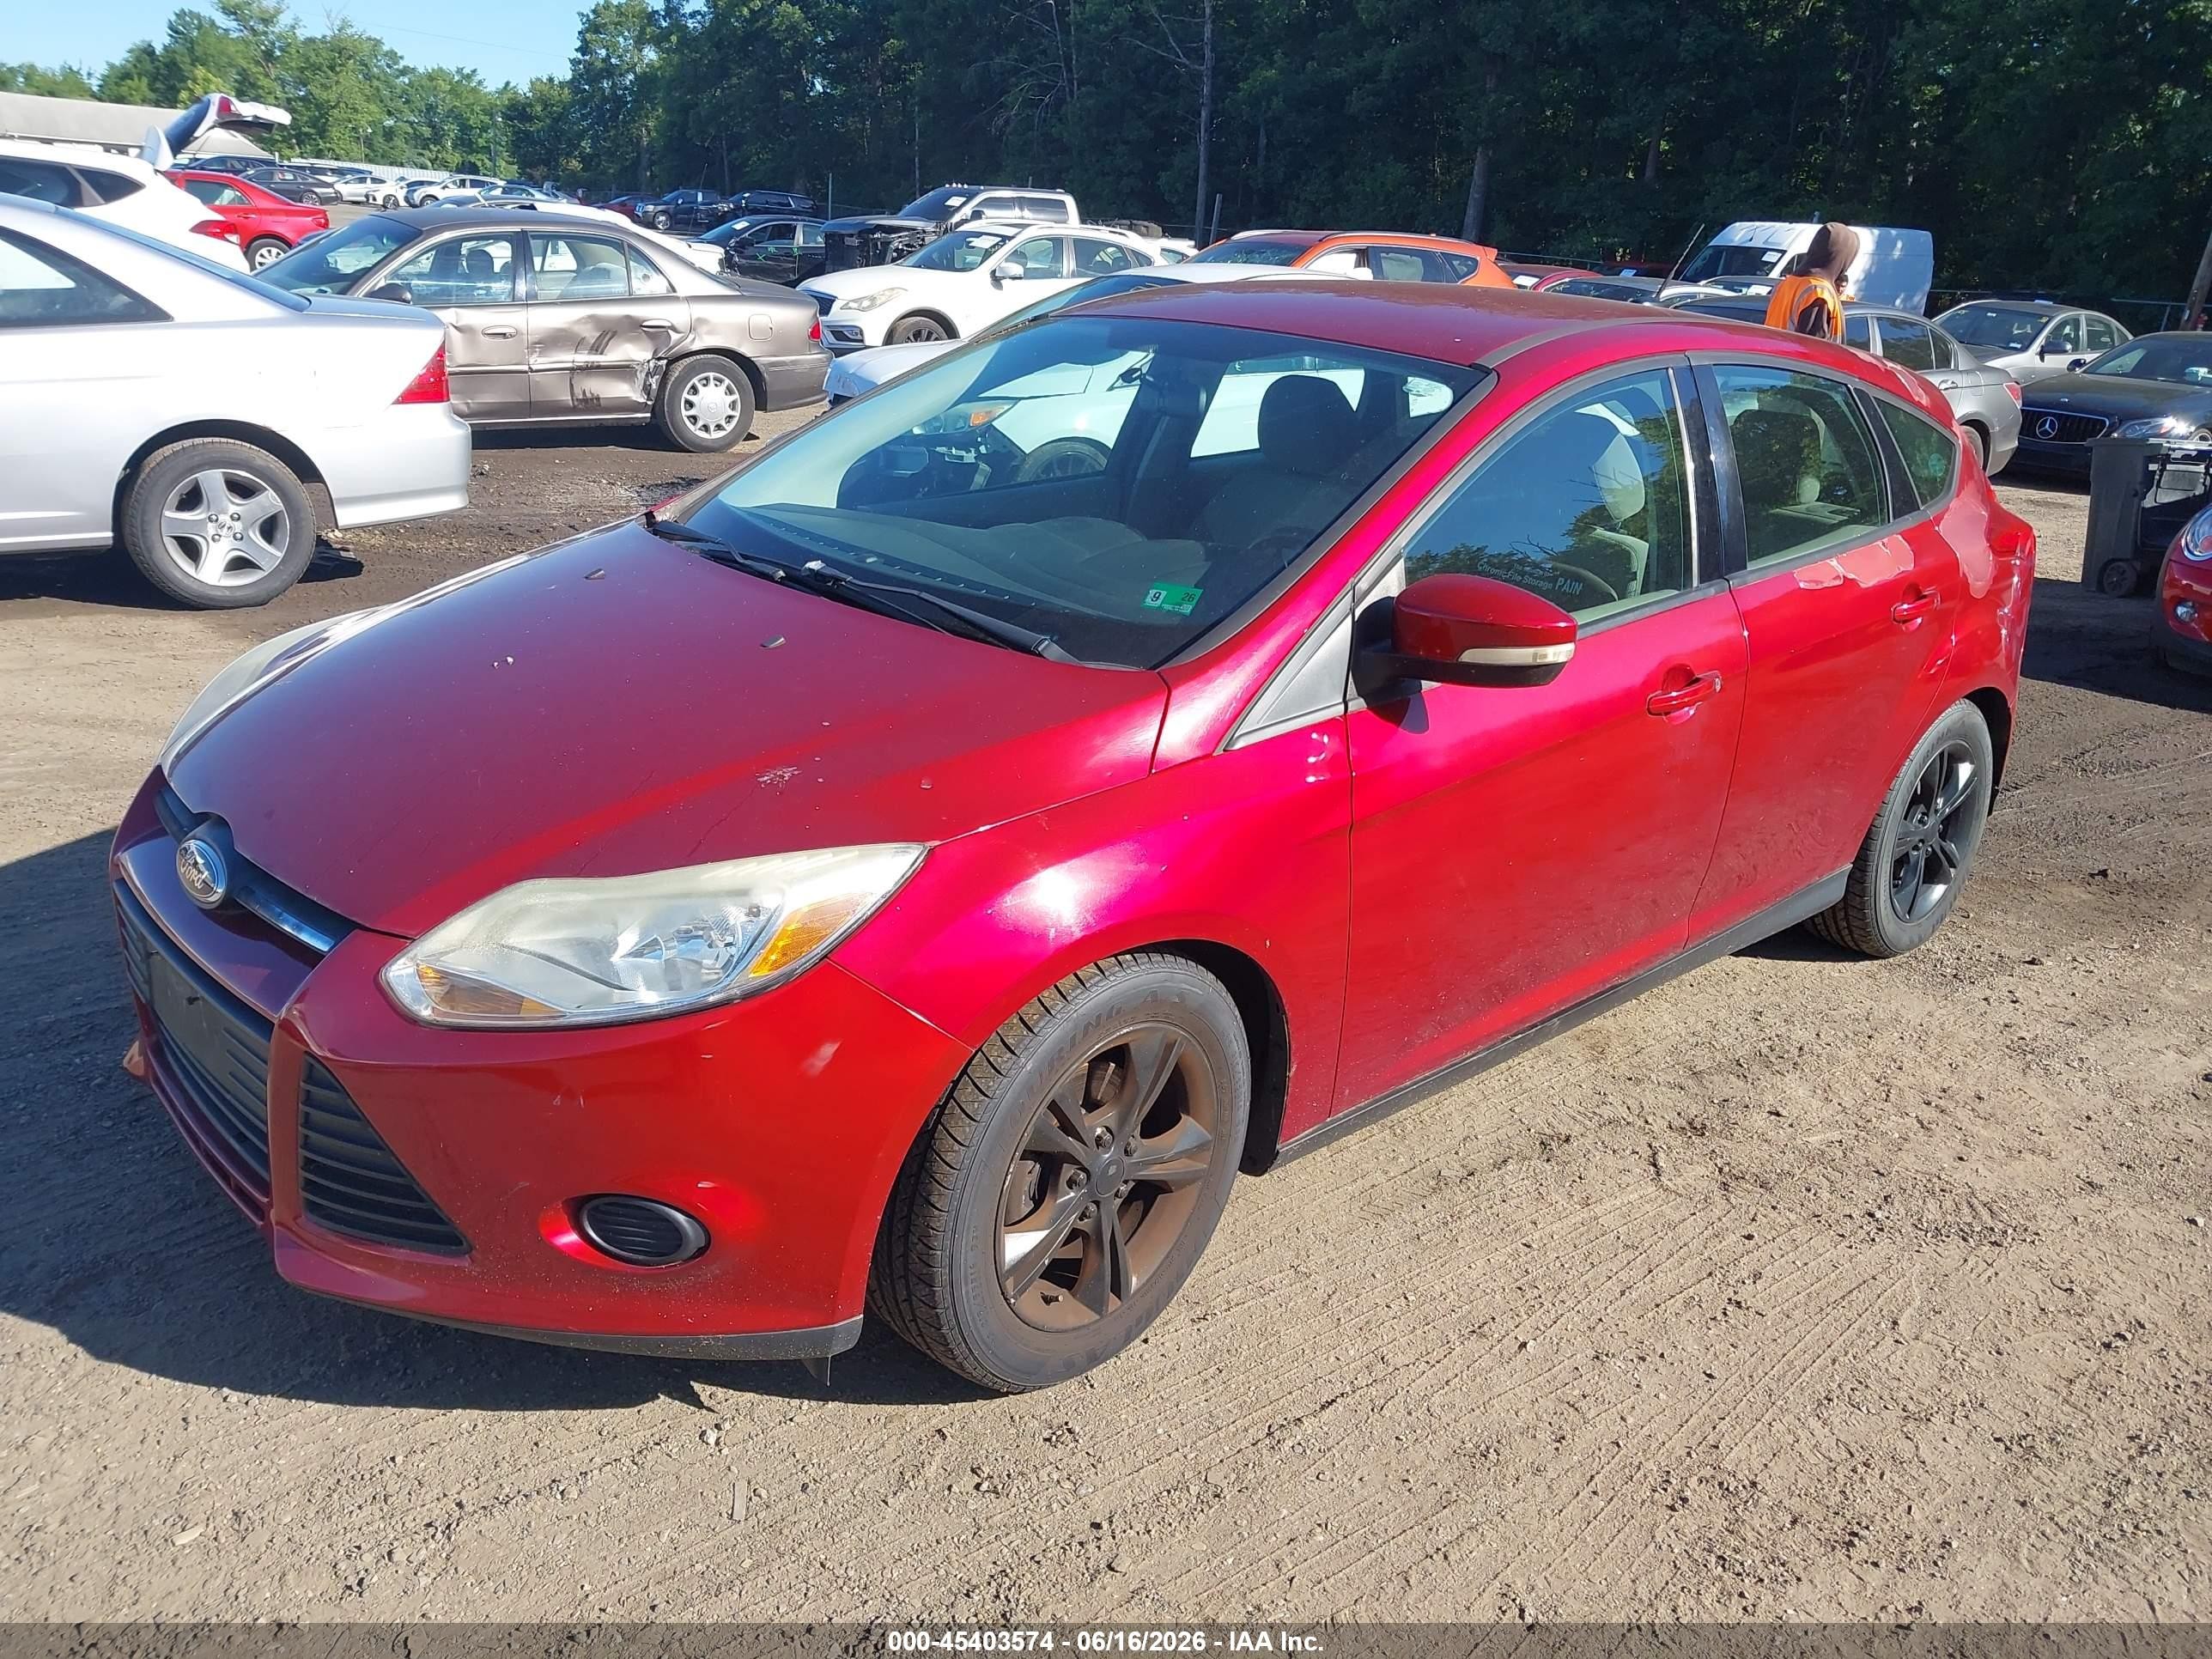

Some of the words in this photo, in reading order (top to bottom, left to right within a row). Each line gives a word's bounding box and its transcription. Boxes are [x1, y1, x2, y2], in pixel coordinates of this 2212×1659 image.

[1555, 578, 1583, 594] PAIN
[1151, 592, 1162, 602] 9
[1181, 592, 1196, 602] 26
[179, 854, 209, 890] Ford
